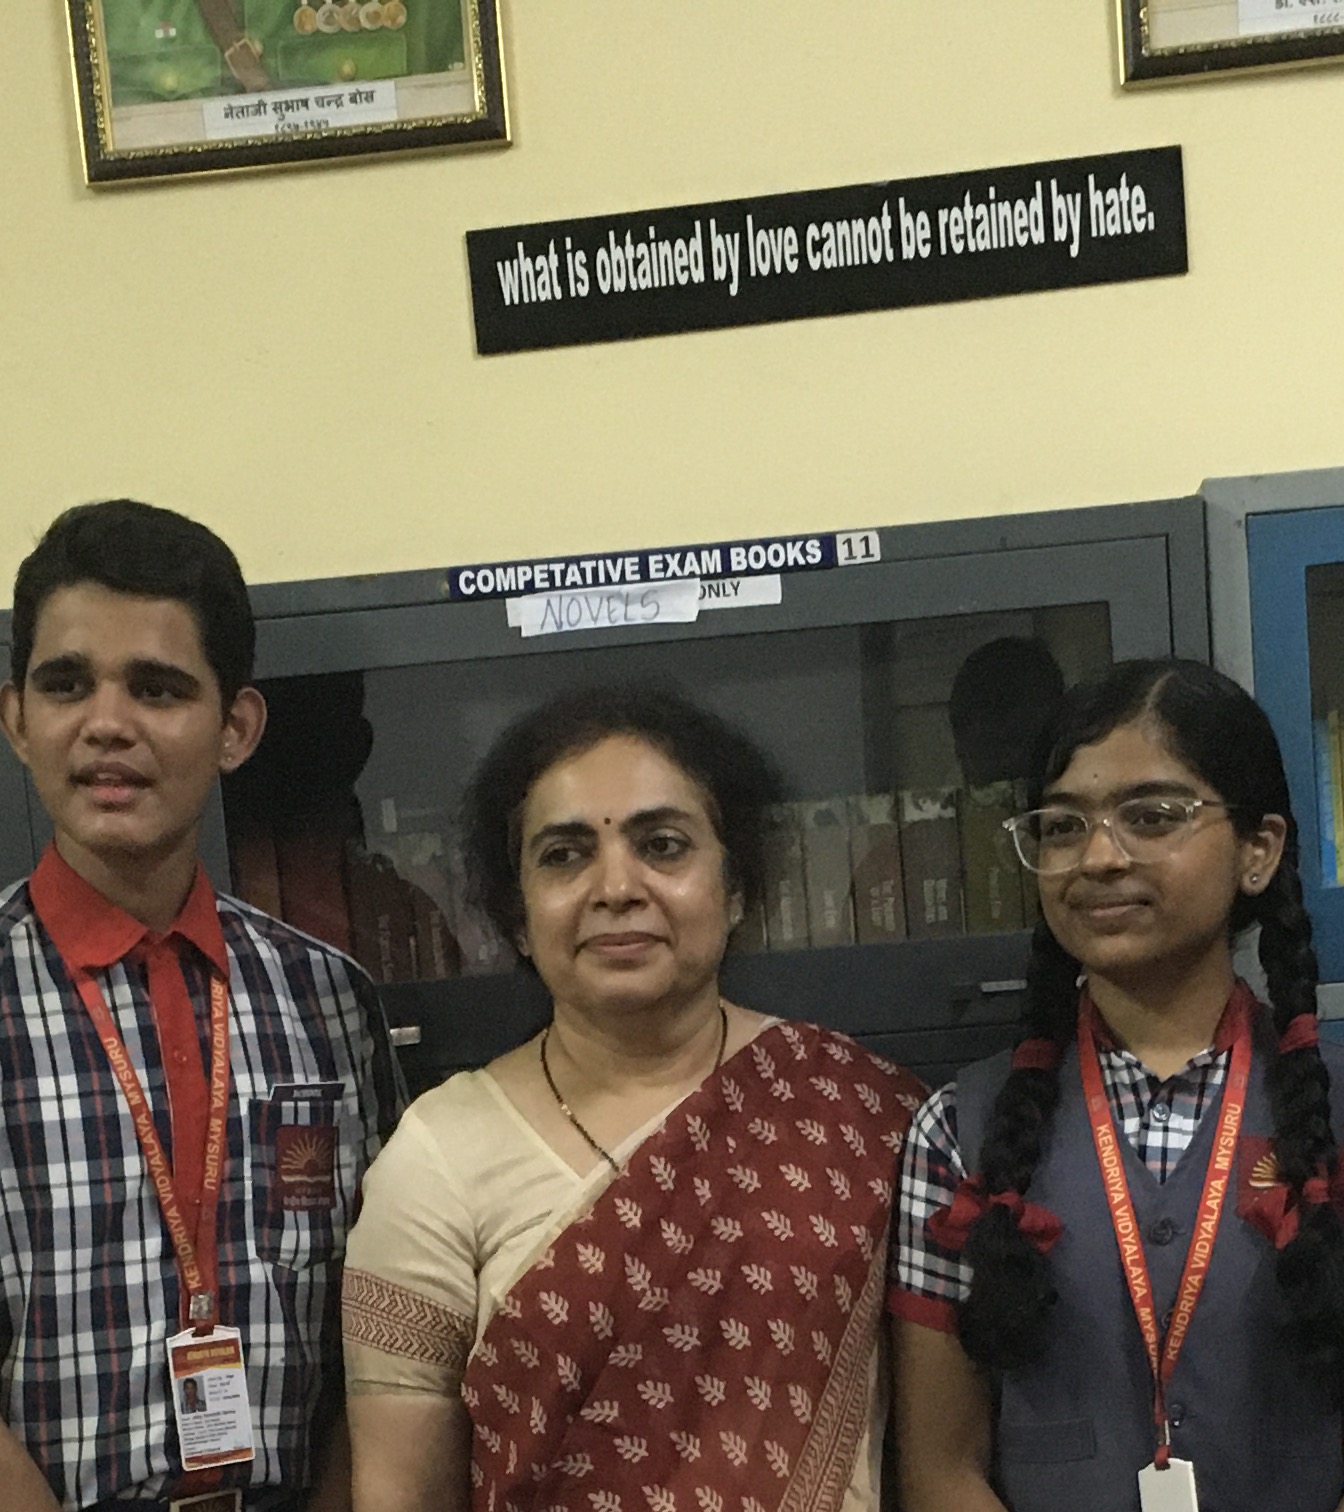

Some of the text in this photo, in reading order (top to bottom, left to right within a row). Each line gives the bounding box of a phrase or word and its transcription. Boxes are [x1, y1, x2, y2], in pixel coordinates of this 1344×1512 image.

[496, 172, 1156, 306] what is obtained by love cannot be retained by hate.
[457, 536, 875, 596] COMPETATIVE EXAM BOOKS 11
[539, 589, 662, 632] NOVELS
[105, 1036, 143, 1106] MYSURU
[203, 1118, 223, 1191] MYSURU
[1096, 1122, 1125, 1204] KENDRIYA
[166, 1204, 202, 1290] KENDRIYA
[1166, 1273, 1203, 1361] KENDRIYA
[1214, 1102, 1243, 1171] MYSURU
